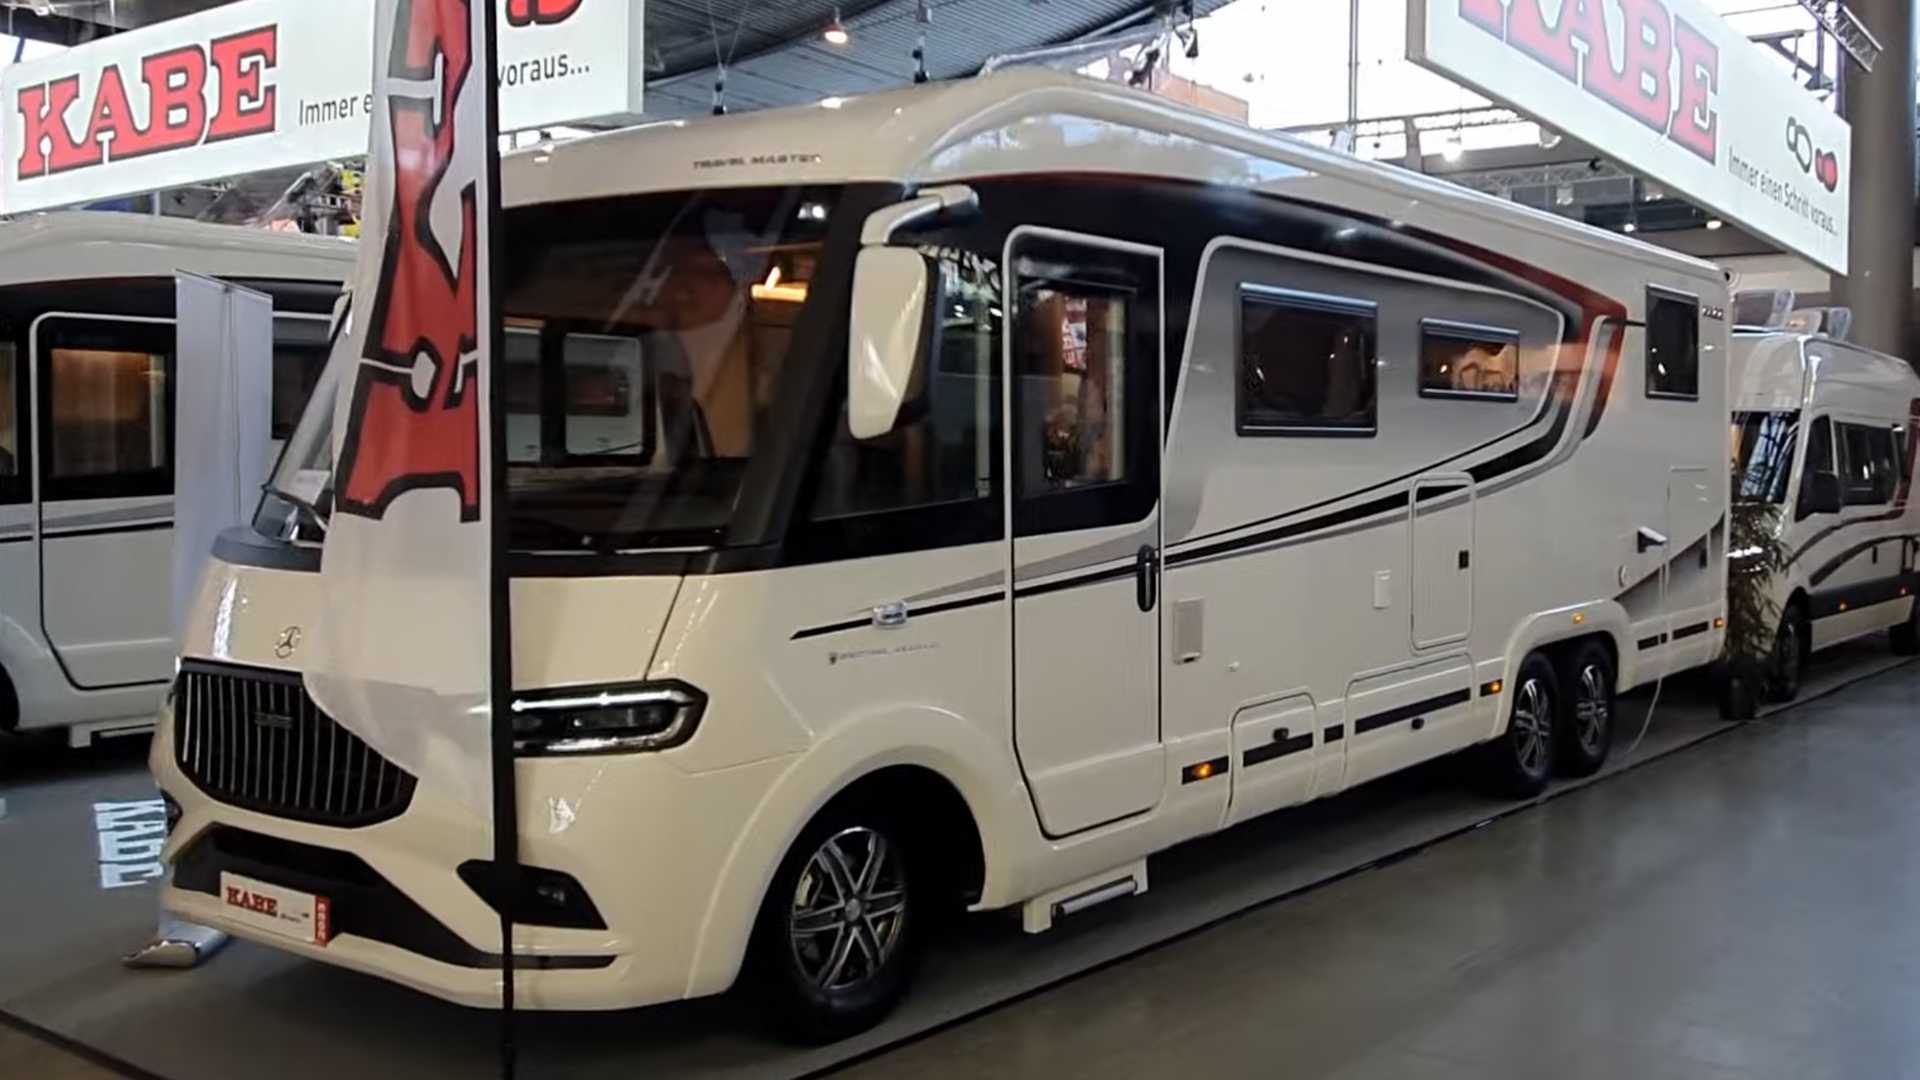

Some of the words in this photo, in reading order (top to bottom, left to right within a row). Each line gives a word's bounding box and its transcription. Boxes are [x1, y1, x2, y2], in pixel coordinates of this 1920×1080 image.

[17, 24, 278, 181] KABE
[299, 95, 358, 126] Immer
[1728, 144, 1759, 189] Immer
[1760, 169, 1783, 204] einen
[226, 885, 279, 918] KABE
